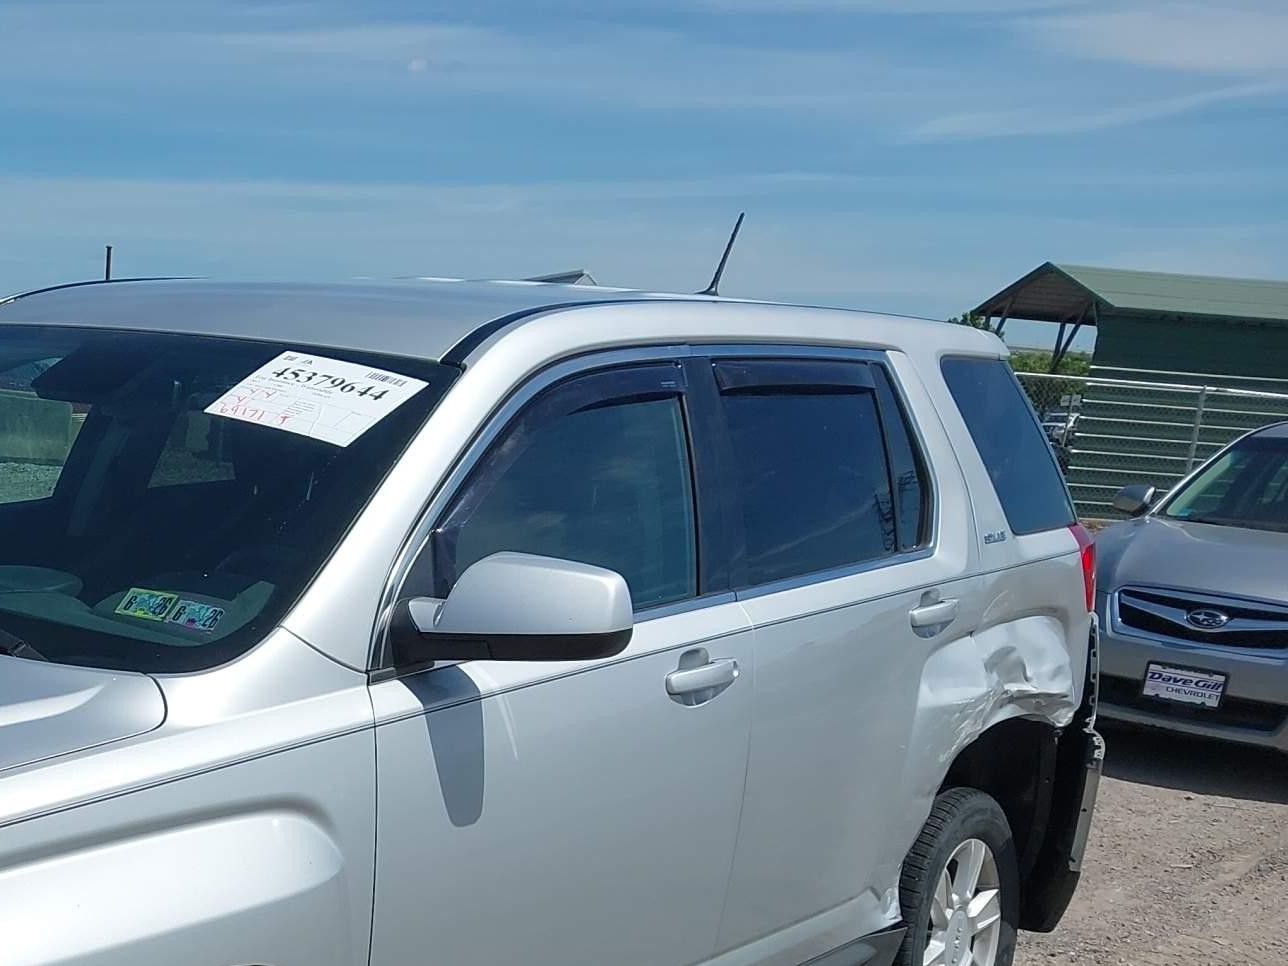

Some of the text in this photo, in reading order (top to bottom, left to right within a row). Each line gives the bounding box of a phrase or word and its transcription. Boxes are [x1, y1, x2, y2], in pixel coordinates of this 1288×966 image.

[271, 367, 390, 401] 45379644
[1148, 671, 1224, 691] Dave Gill
[1166, 686, 1220, 700] CHEVROLET
